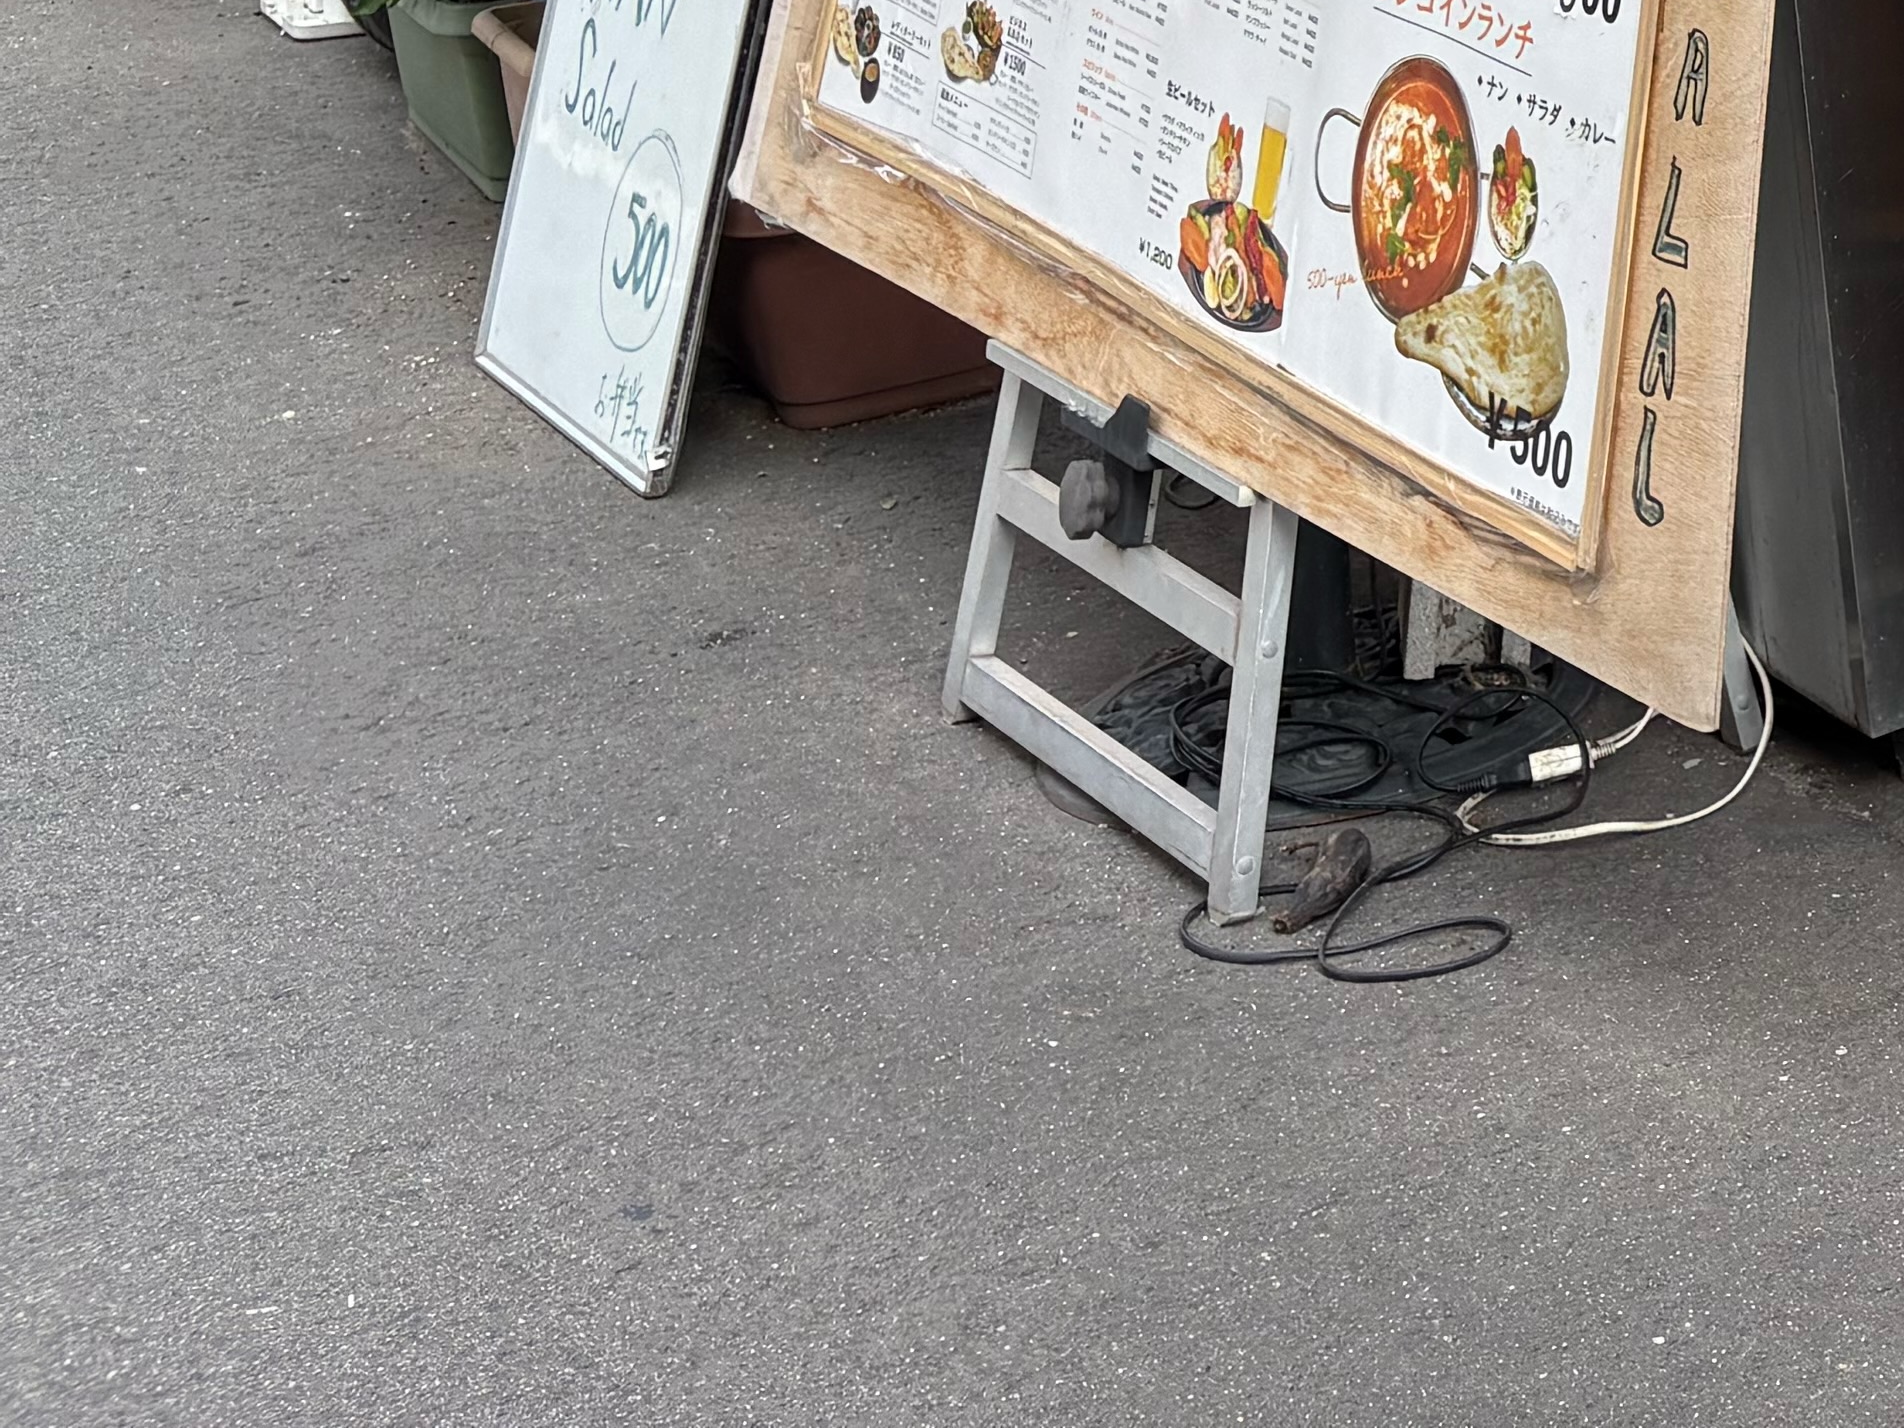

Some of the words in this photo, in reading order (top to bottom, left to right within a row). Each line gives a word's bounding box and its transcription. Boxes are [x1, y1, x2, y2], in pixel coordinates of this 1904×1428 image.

[562, 15, 638, 154] Salad
[1484, 73, 1509, 105] ナン
[1524, 89, 1565, 125] サラダ
[612, 190, 670, 311] 500
